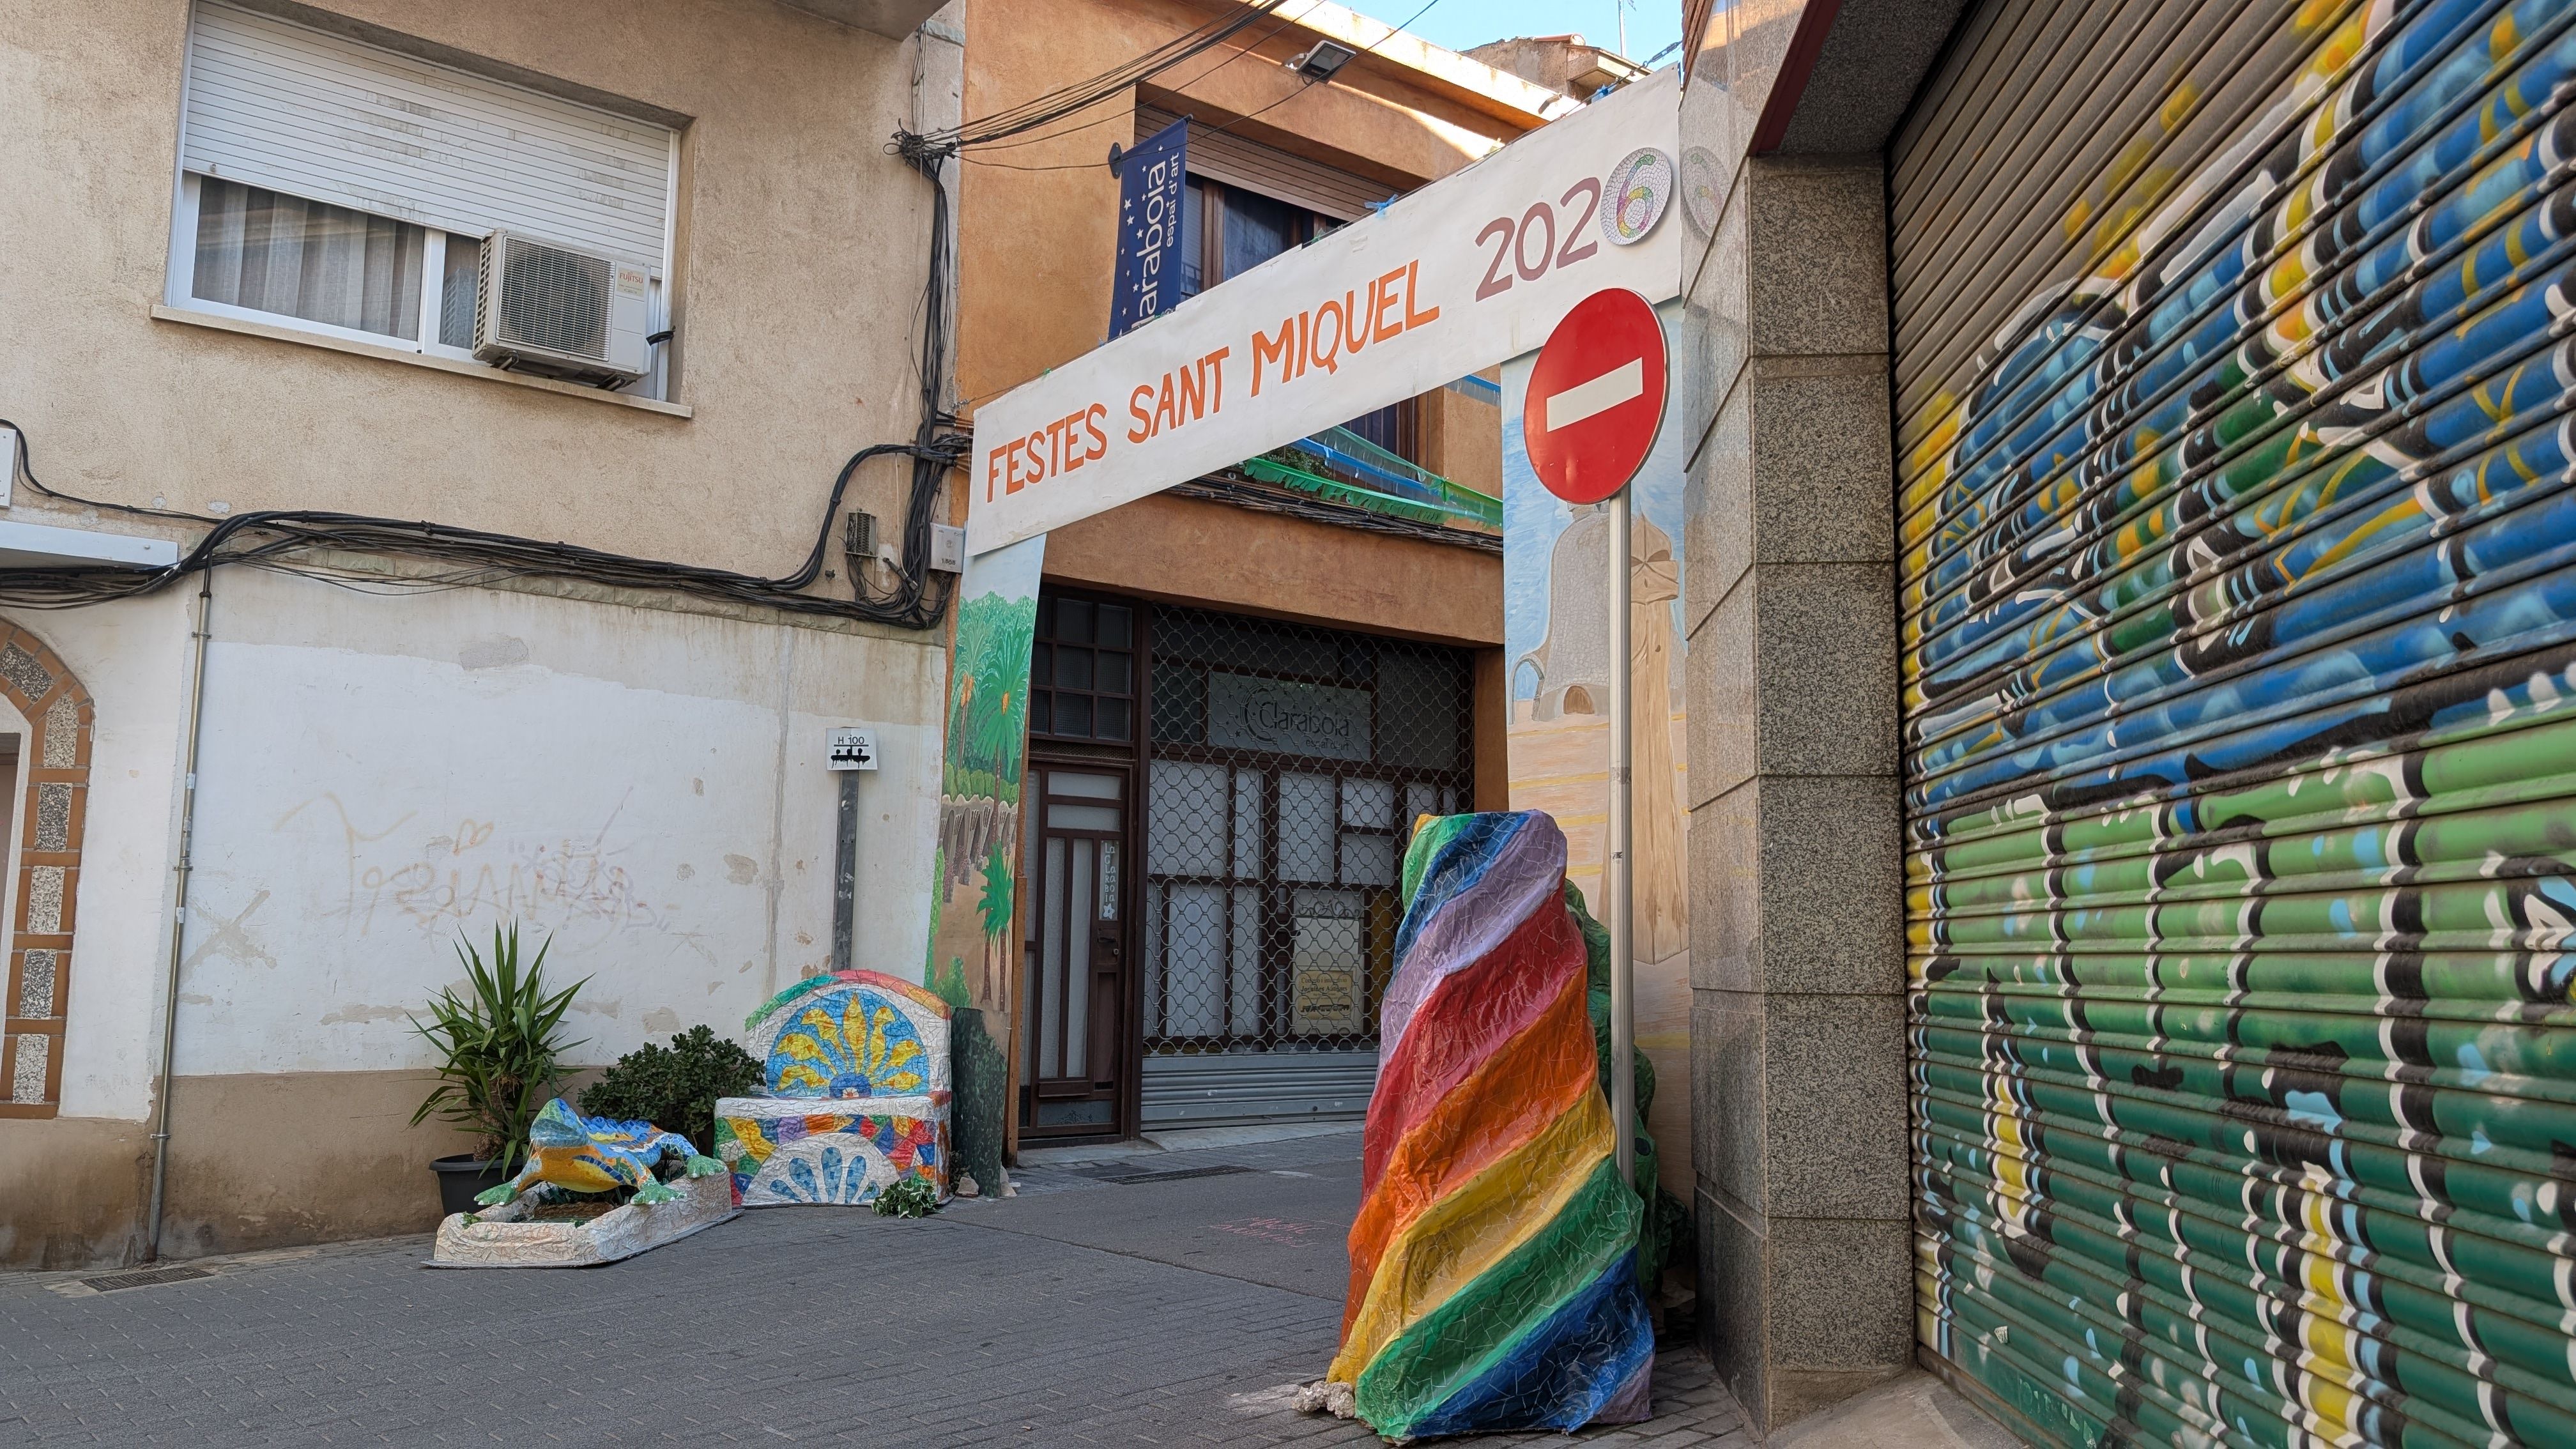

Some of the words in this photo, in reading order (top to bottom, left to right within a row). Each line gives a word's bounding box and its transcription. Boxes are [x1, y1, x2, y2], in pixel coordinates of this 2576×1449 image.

[1169, 152, 1179, 194] d'art
[1166, 201, 1178, 247] espai
[619, 272, 643, 284] FUJITSU
[987, 402, 1107, 503] FESTES
[1127, 346, 1230, 444] SANT
[1251, 259, 1440, 398] MIQUEL
[1475, 154, 1657, 303] 2026
[838, 736, 844, 744] H
[848, 736, 865, 744] 100
